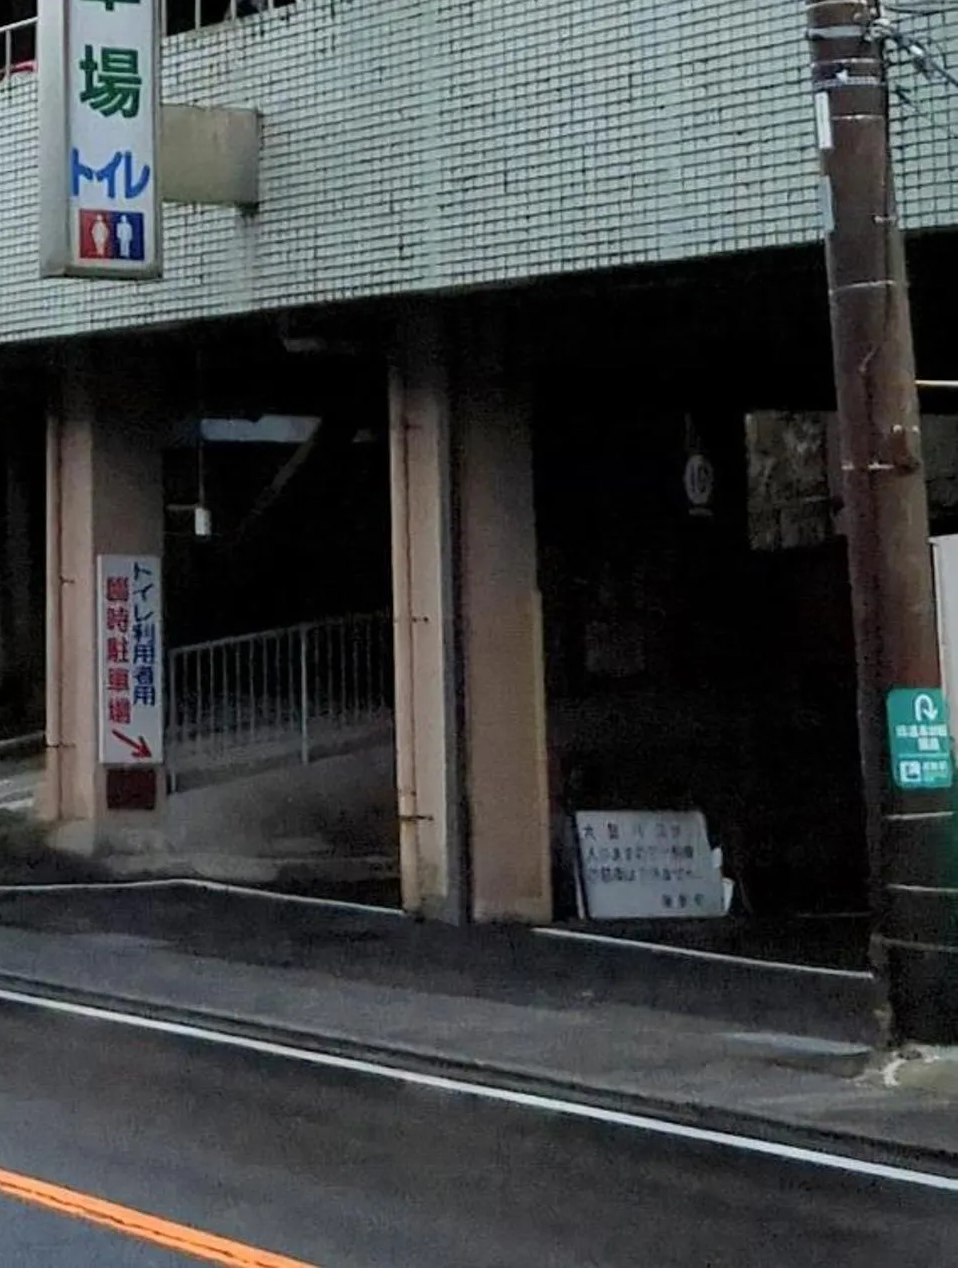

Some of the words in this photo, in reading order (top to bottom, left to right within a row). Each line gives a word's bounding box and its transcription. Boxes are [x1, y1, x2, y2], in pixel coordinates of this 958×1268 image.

[71, 146, 151, 201] トイレ
[133, 561, 156, 708] トイレ利用者用
